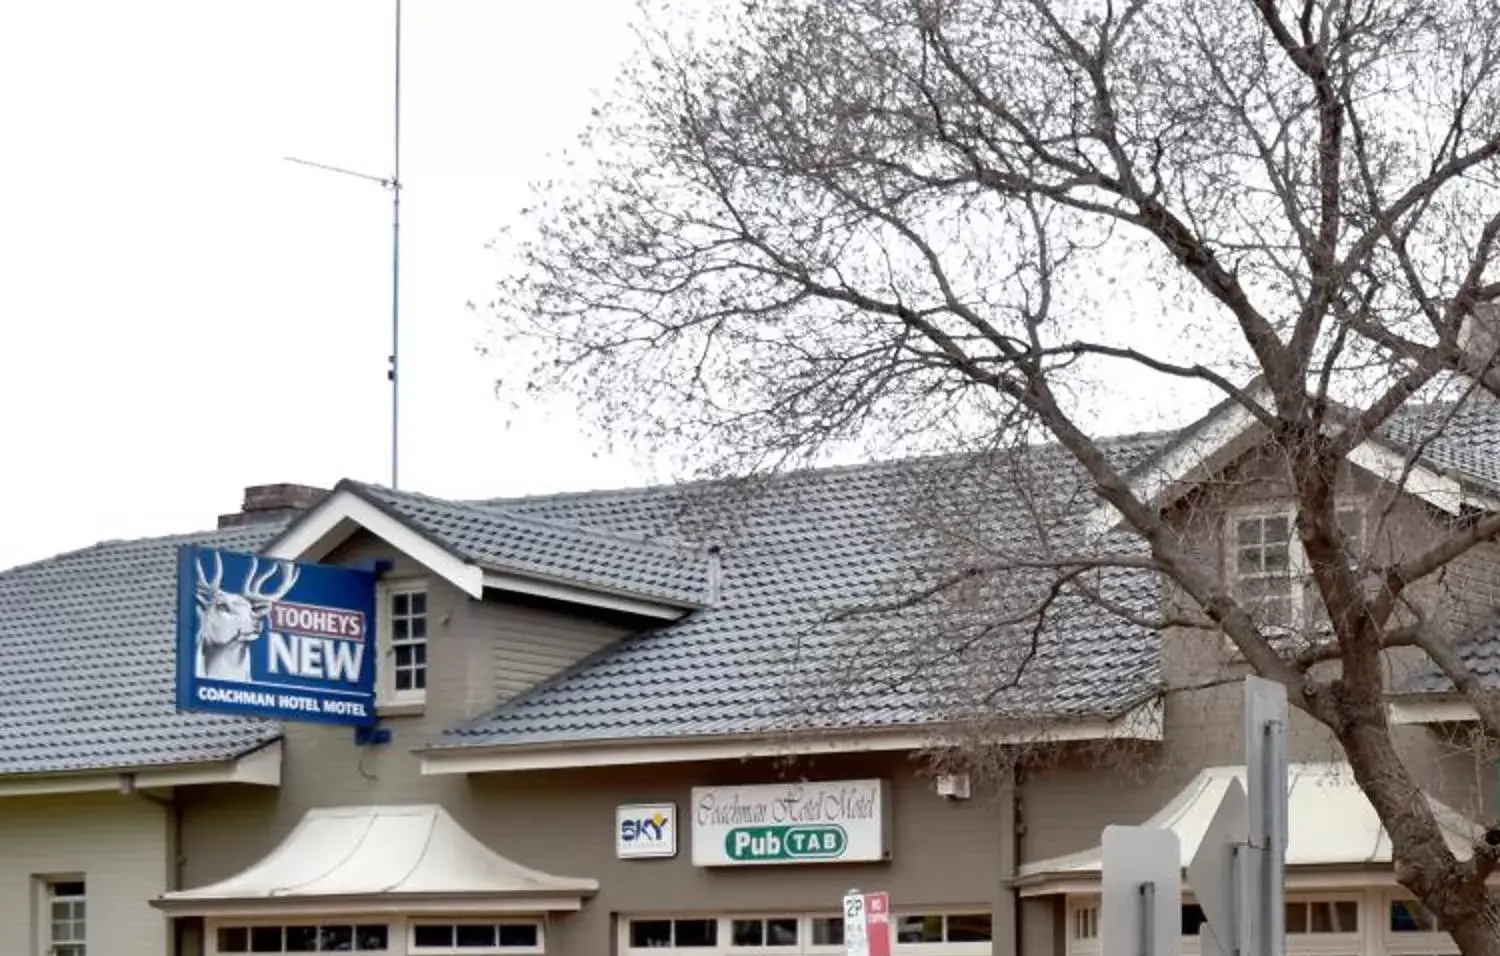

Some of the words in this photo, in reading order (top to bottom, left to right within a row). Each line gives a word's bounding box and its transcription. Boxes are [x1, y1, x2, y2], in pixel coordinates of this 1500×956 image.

[274, 606, 362, 636] TOOHEYS
[268, 632, 366, 684] NEW
[198, 686, 275, 708] COACHMAN
[278, 694, 321, 713] HOTEL
[323, 700, 368, 717] MOTEL
[771, 785, 824, 823] Hotel
[621, 815, 668, 841] SKY
[734, 830, 782, 857] Pub
[793, 832, 838, 851] TAB
